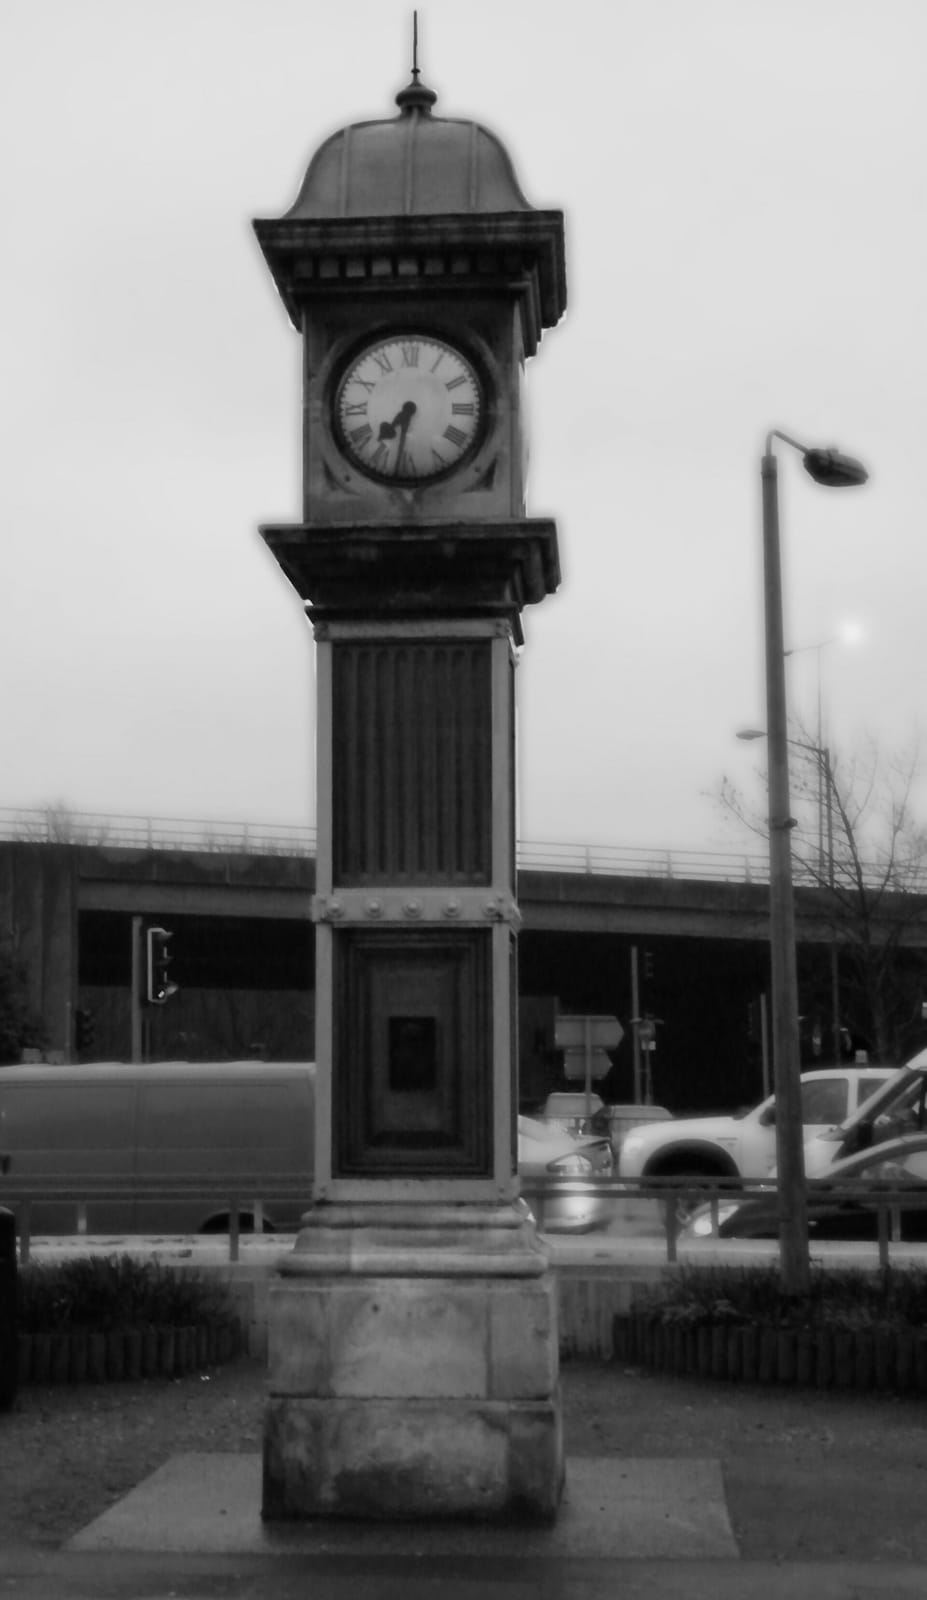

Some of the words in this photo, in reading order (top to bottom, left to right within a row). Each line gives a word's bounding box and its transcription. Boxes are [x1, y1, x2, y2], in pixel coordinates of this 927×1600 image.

[401, 346, 420, 369] XII
[444, 375, 468, 392] II
[451, 402, 475, 416] III
